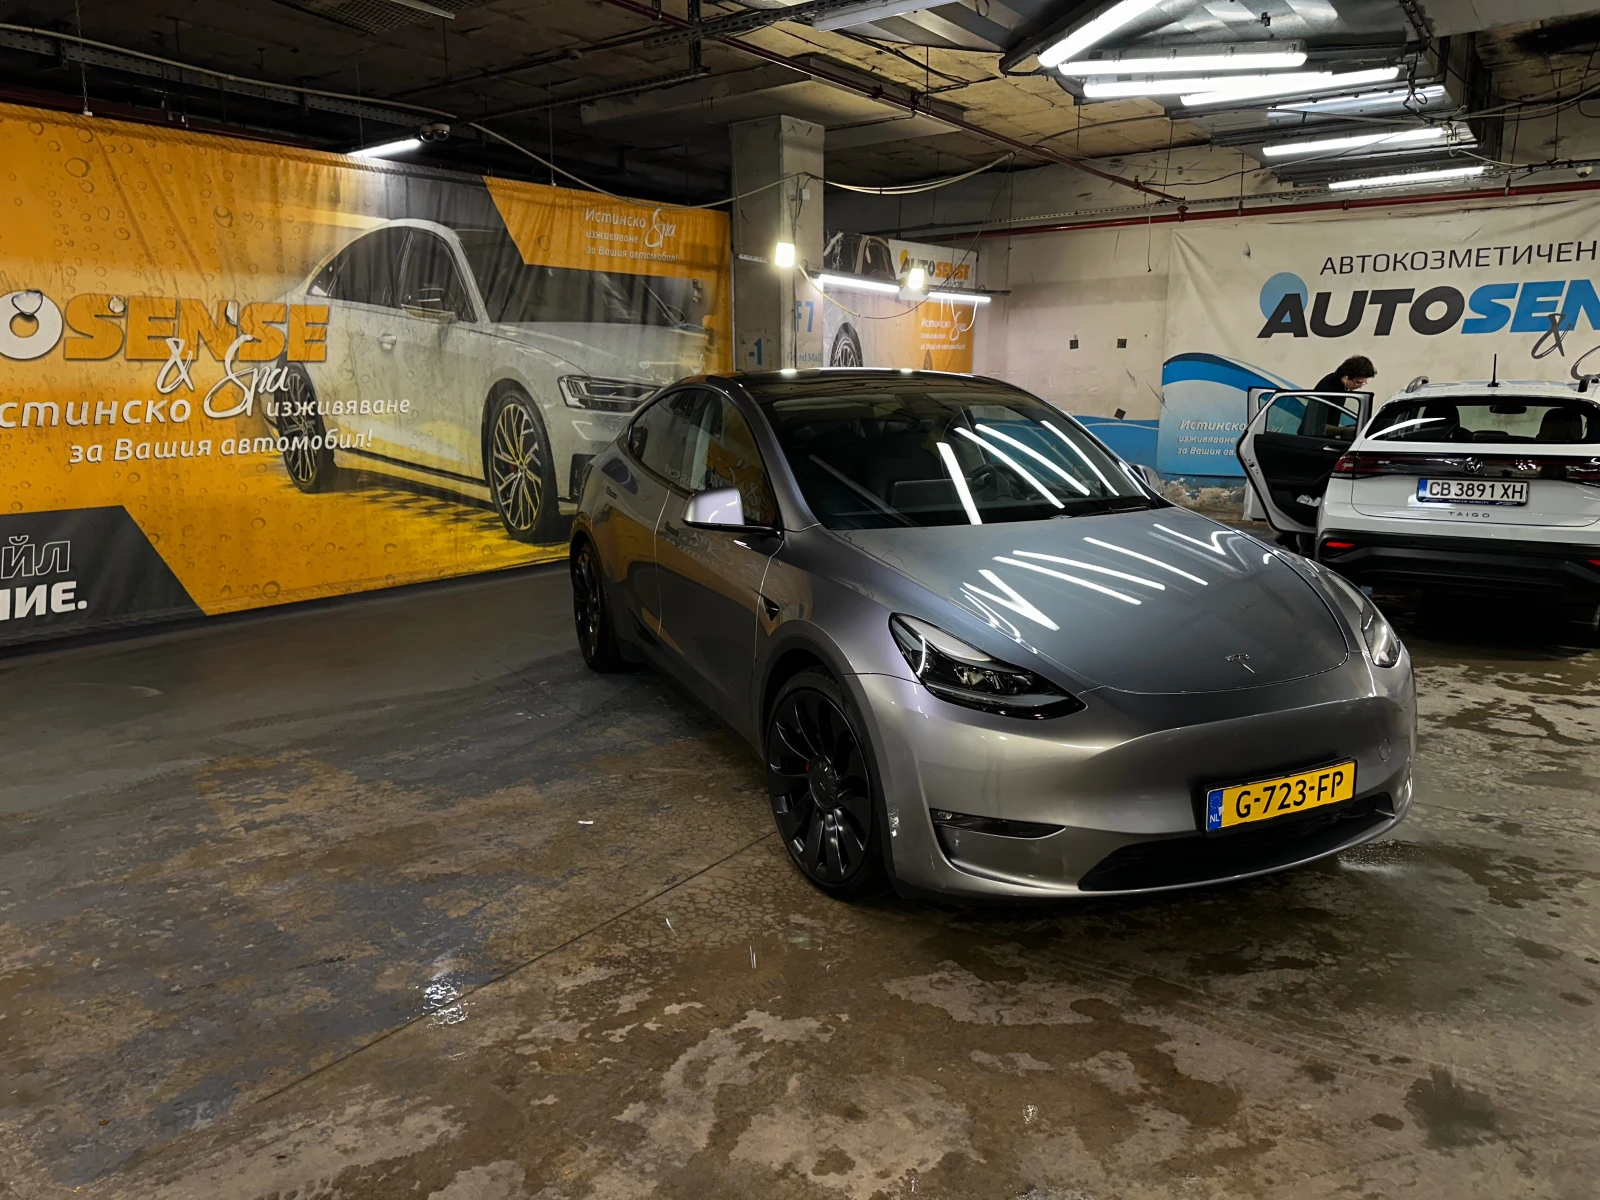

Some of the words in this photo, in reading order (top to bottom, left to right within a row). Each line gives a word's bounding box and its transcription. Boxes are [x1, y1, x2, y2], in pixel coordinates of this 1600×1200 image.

[585, 208, 646, 228] Истинско
[645, 208, 676, 248] Spa
[585, 231, 638, 243] изживяване
[587, 246, 596, 255] за
[598, 246, 627, 257] Вашия
[630, 251, 678, 262] автомобил!
[1320, 240, 1597, 275] АВТОКОЗМЕТИЧЕН
[0, 290, 329, 361] OSENSE
[749, 338, 762, 366] -1
[156, 338, 195, 394] &
[203, 334, 290, 419] Spa
[266, 398, 411, 418] изживяване
[1180, 420, 1246, 432] Истинско
[69, 444, 103, 464] за
[114, 438, 212, 462] Вашия
[220, 428, 374, 456] автомобил!
[1178, 435, 1236, 444] изживяване
[1177, 447, 1187, 455] за
[1190, 447, 1220, 456] Вашия
[1429, 482, 1451, 497] CB
[1454, 483, 1495, 498] 3891
[1500, 484, 1524, 499] XH
[1235, 770, 1344, 818] G-723-FP
[1209, 813, 1220, 824] NL
